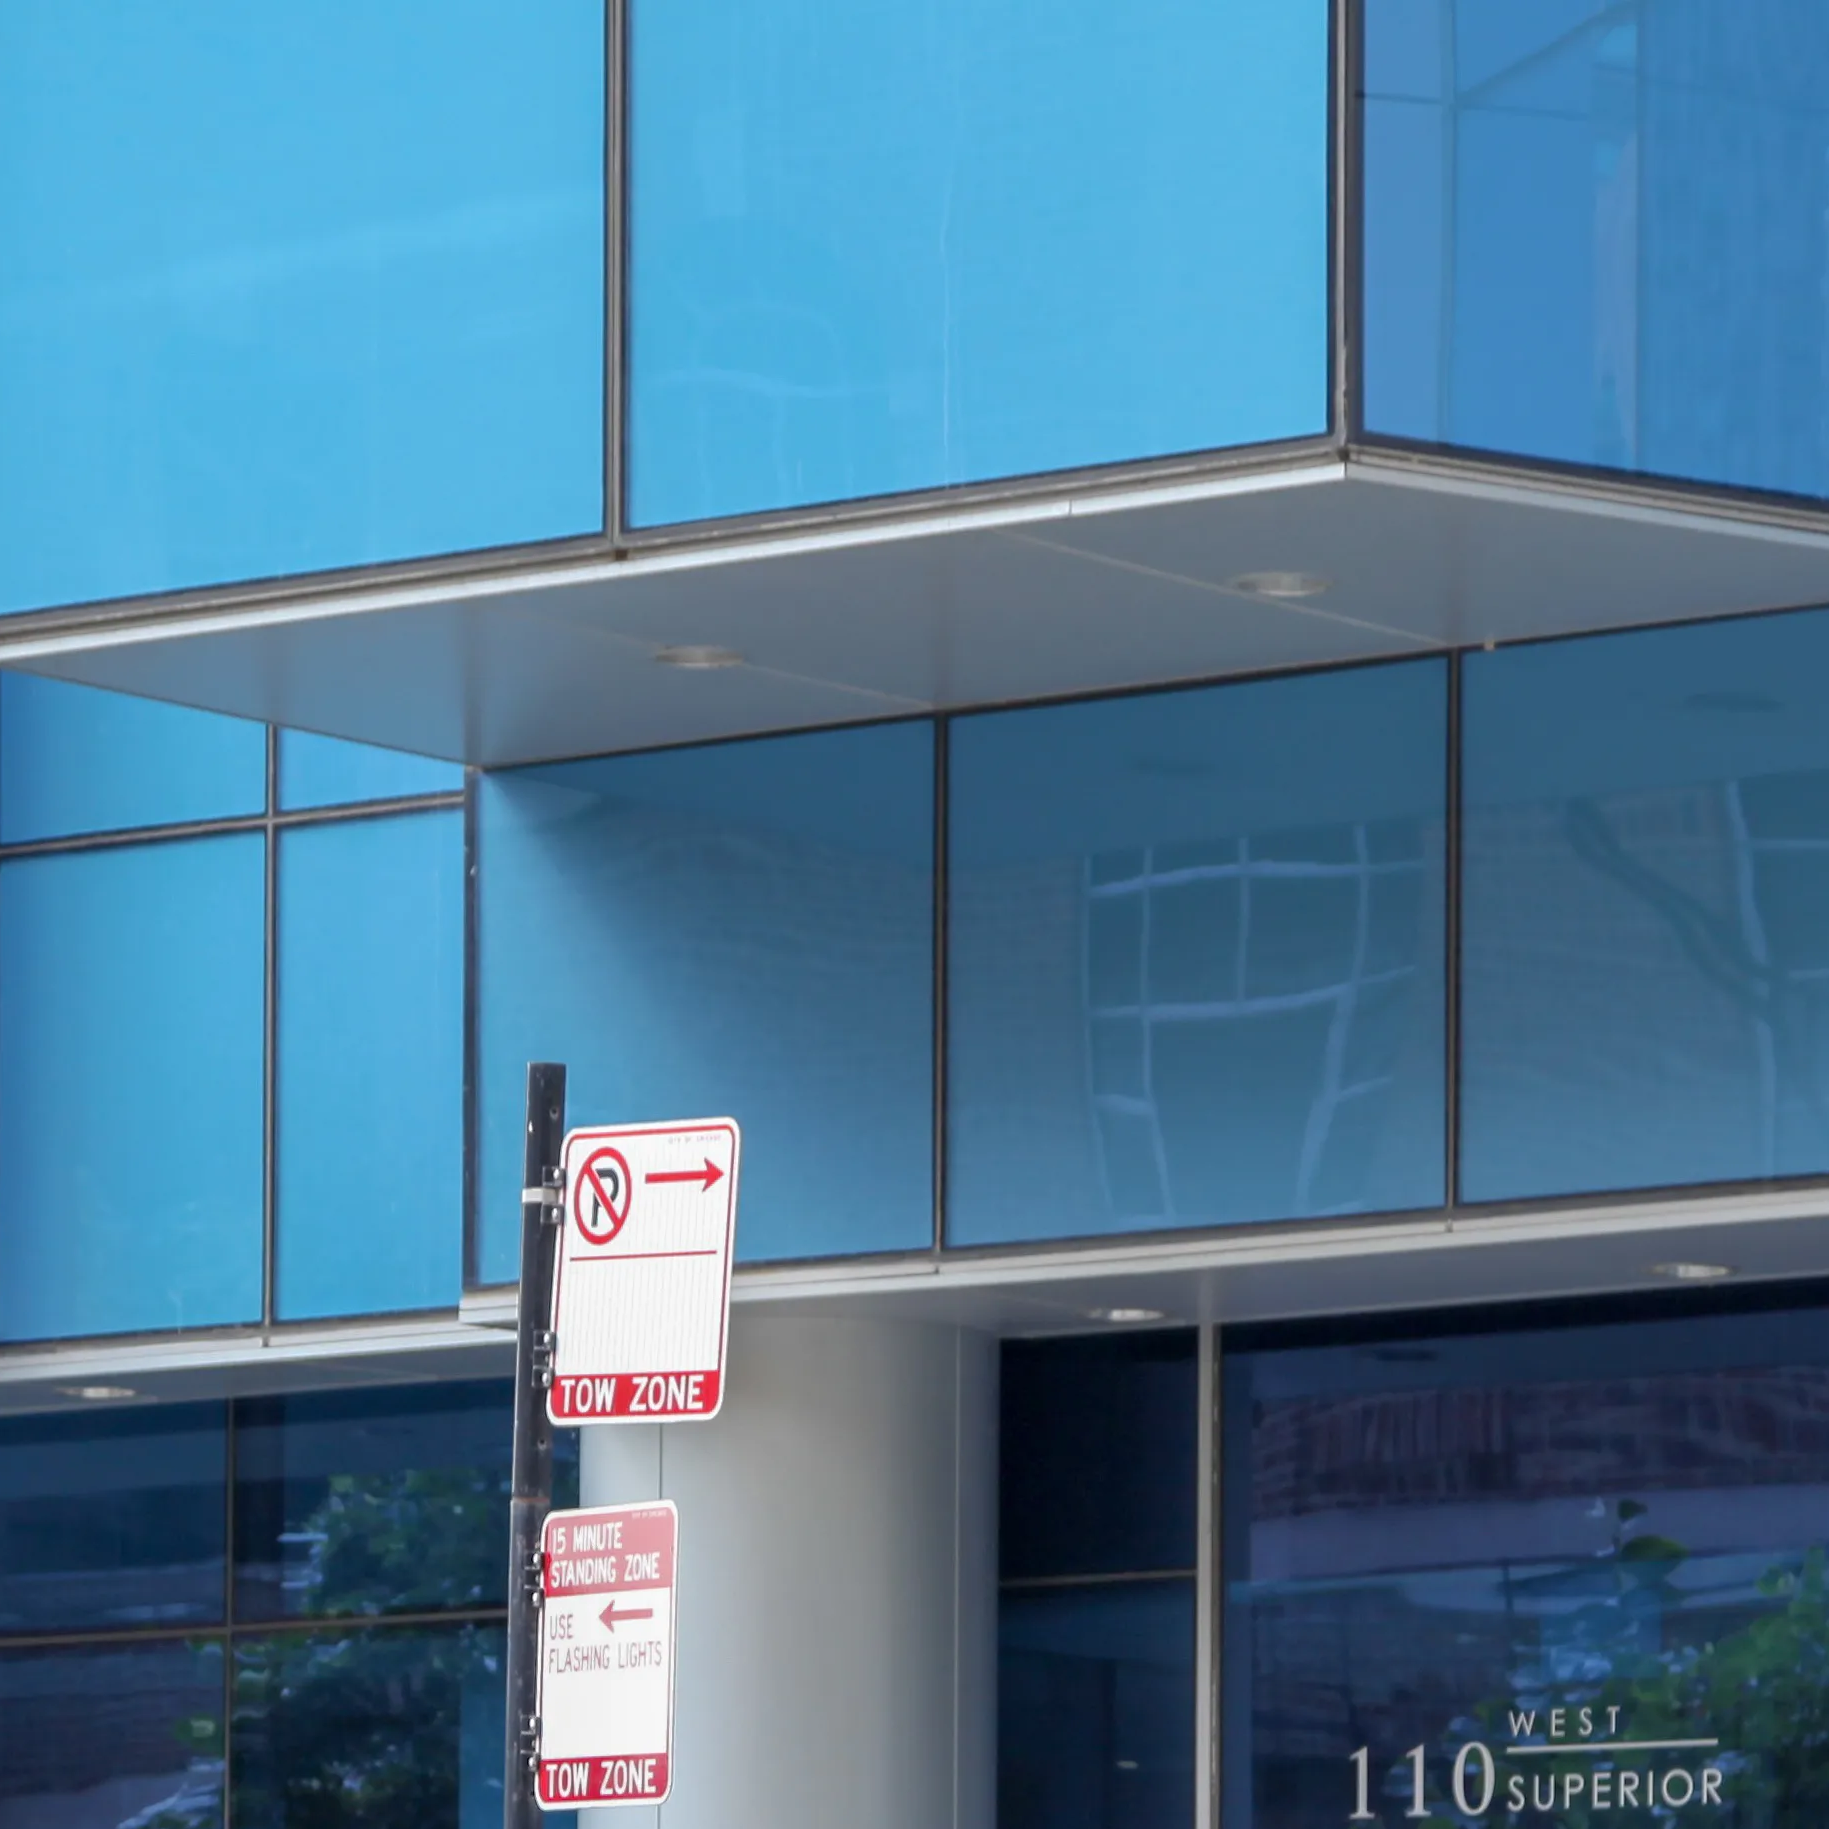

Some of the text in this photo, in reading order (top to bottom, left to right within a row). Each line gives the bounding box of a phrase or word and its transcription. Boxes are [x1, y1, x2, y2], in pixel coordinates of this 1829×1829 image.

[560, 1375, 705, 1414] TOW ZONE
[551, 1521, 624, 1555] 15 MINUTE
[550, 1552, 661, 1589] STANDING ZONE
[549, 1613, 574, 1641] USE
[548, 1640, 663, 1674] FLASHING LIGHTS
[1507, 1705, 1621, 1738] WEST
[545, 1758, 658, 1799] TOW ZONE
[1348, 1740, 1496, 1820] 110
[1506, 1768, 1723, 1813] SUPERIOR
